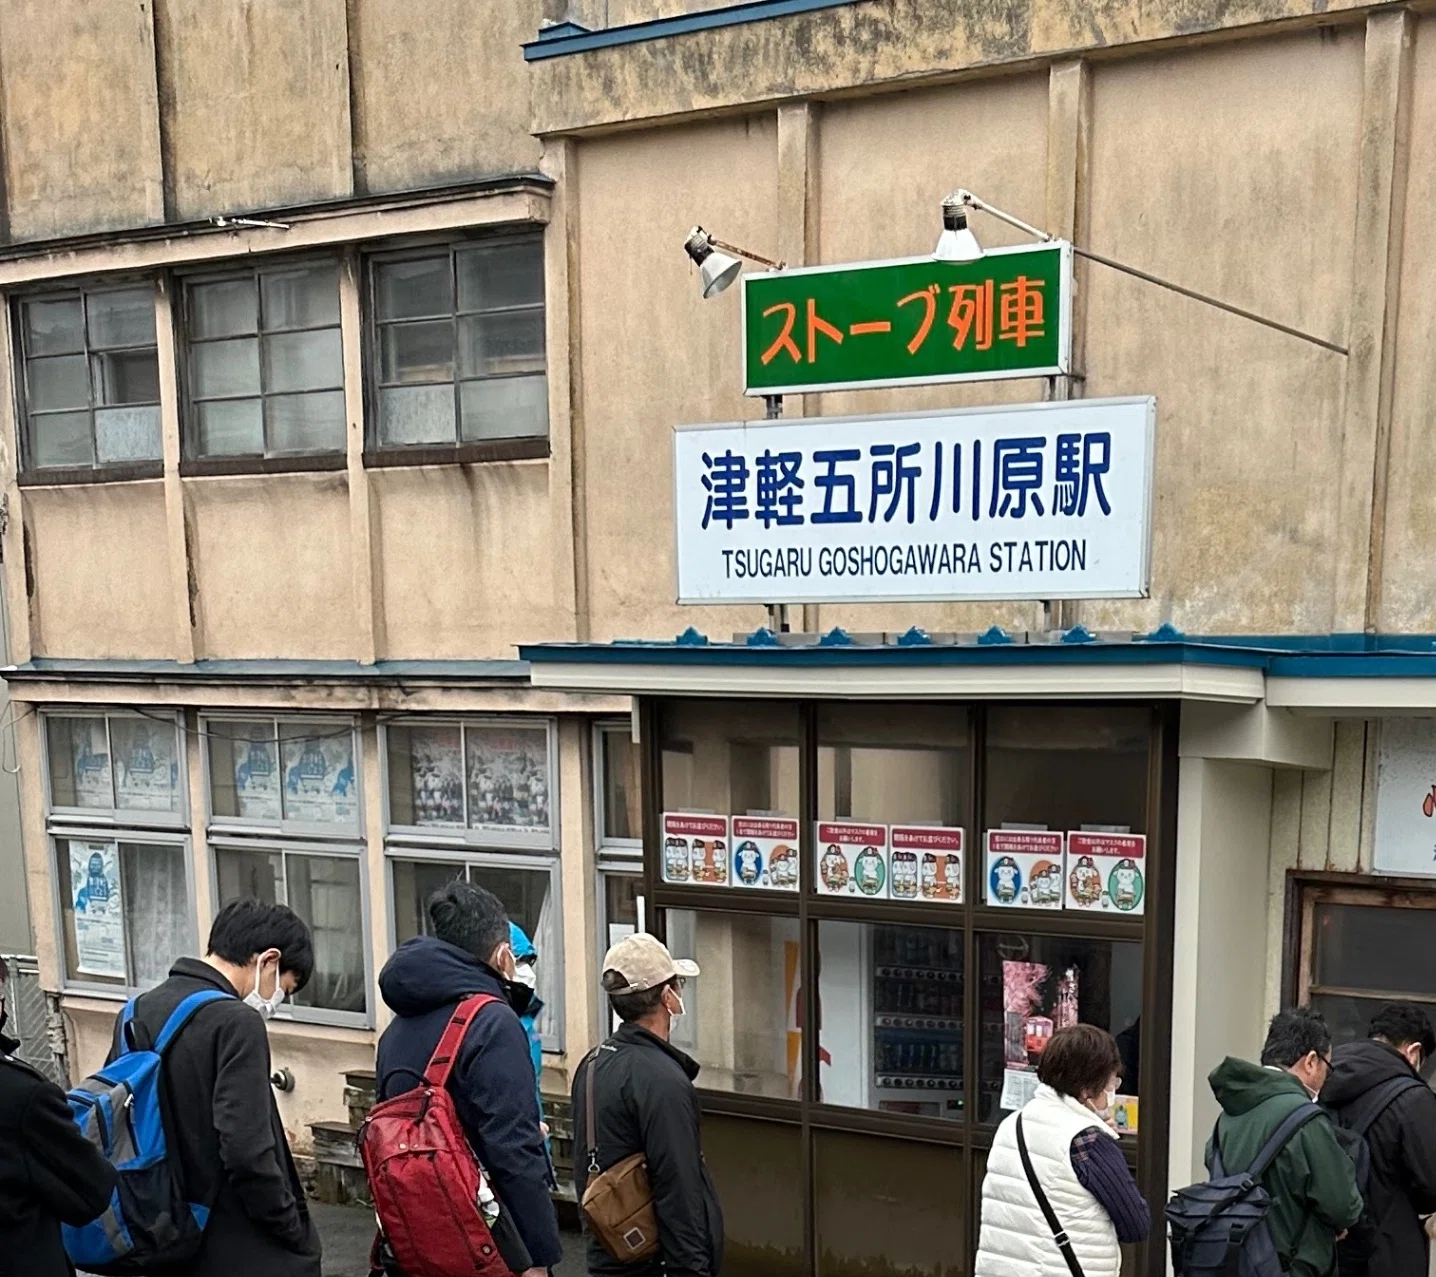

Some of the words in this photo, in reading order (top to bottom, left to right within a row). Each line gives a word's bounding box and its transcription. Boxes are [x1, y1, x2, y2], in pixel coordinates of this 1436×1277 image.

[760, 275, 1047, 366] ストーブ列車
[700, 431, 1112, 531] 津軽五所川原駅
[721, 546, 812, 580] TSUGARU
[818, 541, 982, 578] GOSHOGAWARA
[988, 538, 1087, 575] STATION
